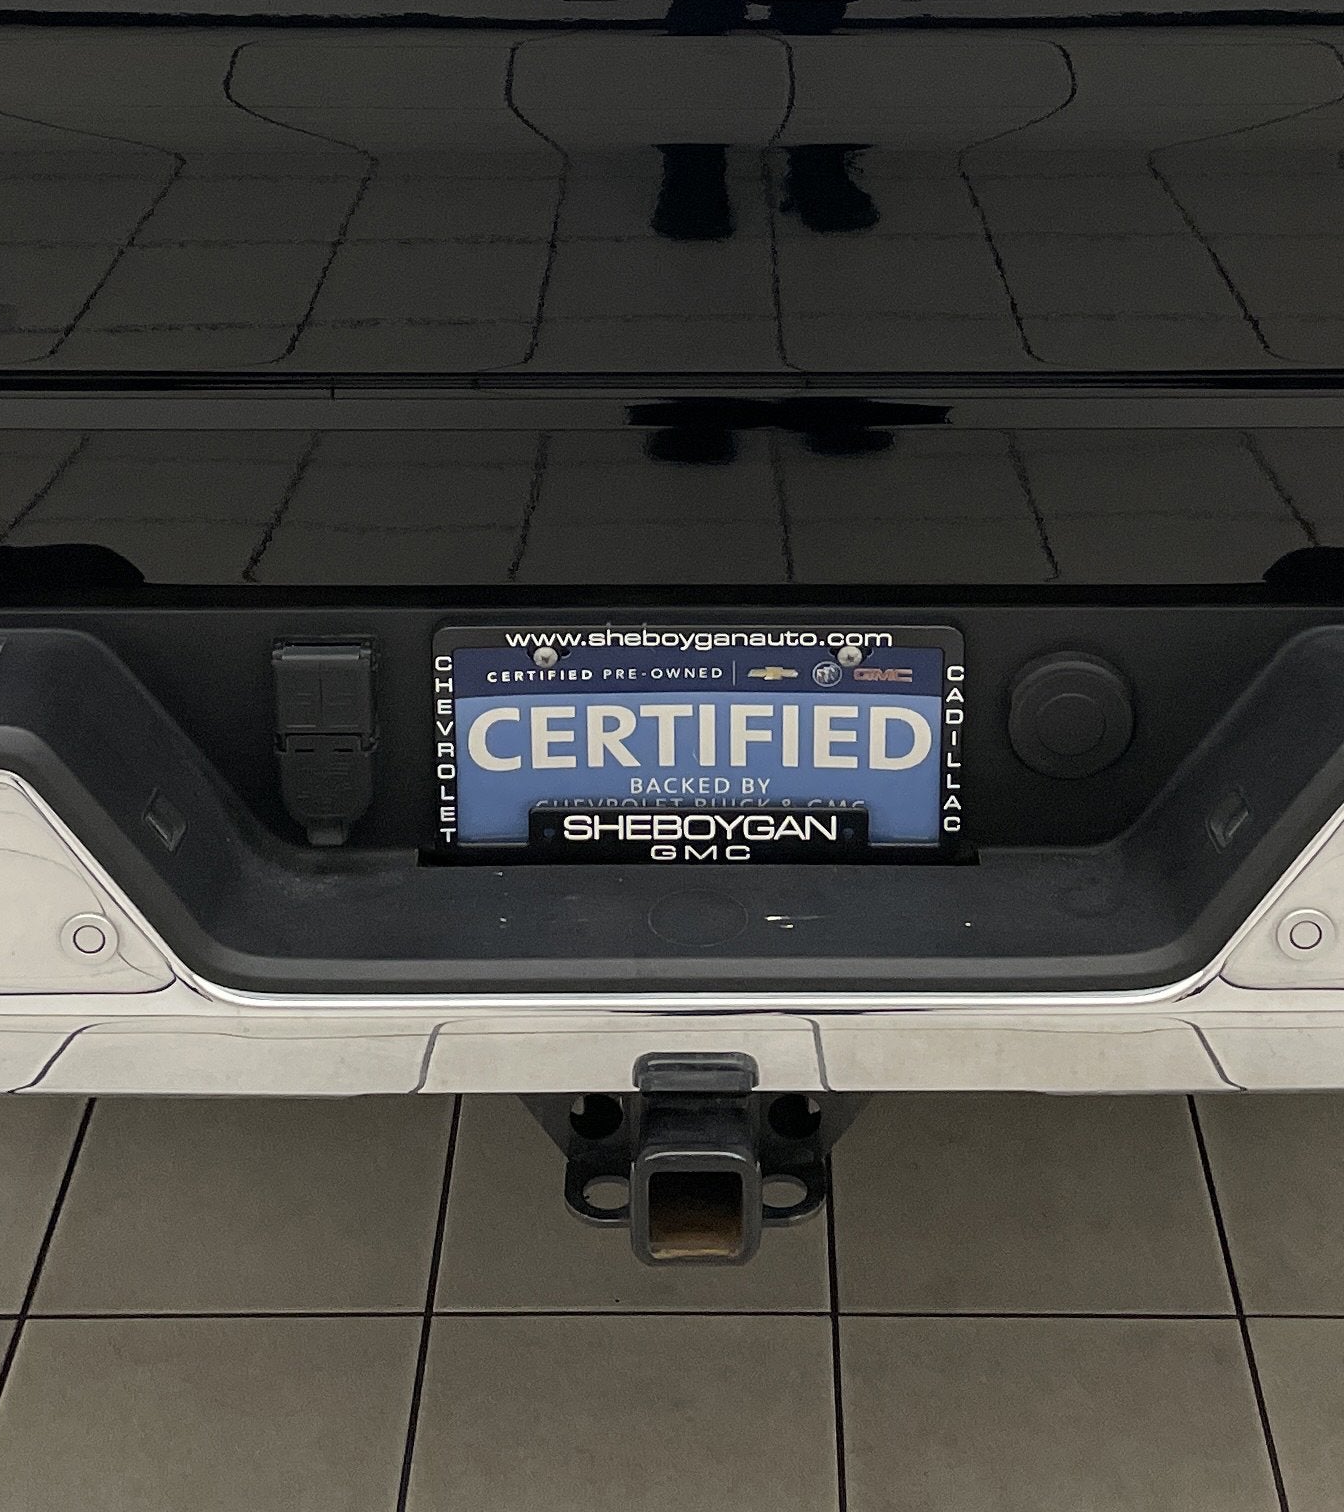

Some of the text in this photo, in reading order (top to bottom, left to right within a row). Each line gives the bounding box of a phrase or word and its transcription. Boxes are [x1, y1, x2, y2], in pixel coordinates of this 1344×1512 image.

[505, 629, 893, 651] www.sheboyganauto.com
[486, 667, 723, 683] CERTIFIED PRE-OWNED
[853, 668, 913, 683] GMC
[467, 704, 932, 772] CERTIFIED
[943, 665, 965, 832] CADILLAC
[434, 656, 457, 843] CHEVROLET
[629, 777, 771, 795] BACKED BY
[563, 814, 838, 841] SHEBOYGAN
[650, 845, 752, 861] GMC
